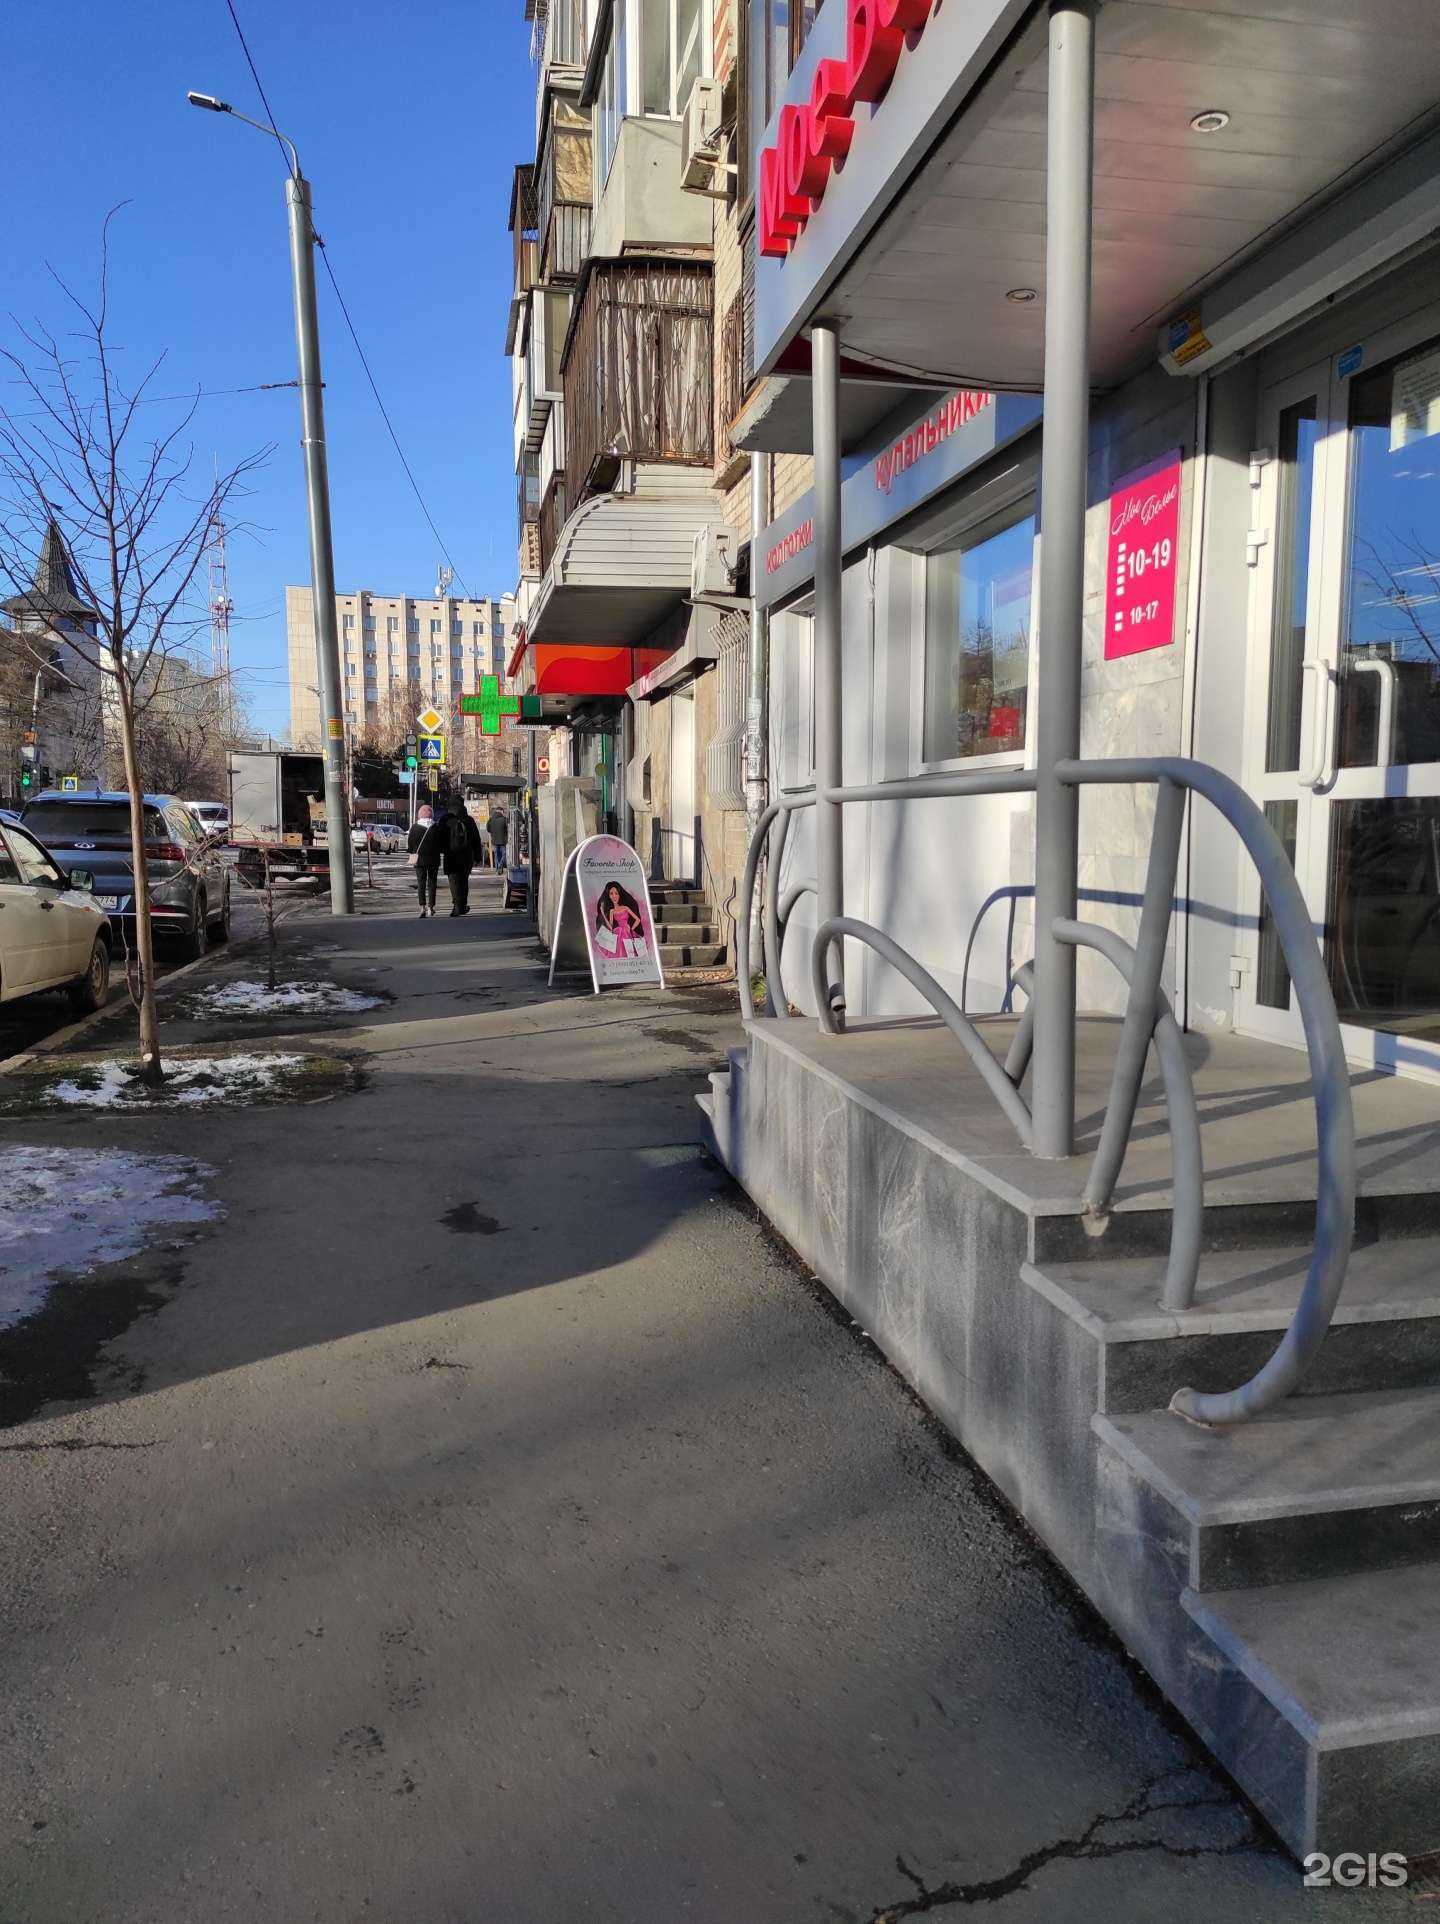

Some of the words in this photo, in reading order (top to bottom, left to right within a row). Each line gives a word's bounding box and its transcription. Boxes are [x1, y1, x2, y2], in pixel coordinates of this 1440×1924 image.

[1127, 537, 1172, 579] 10-19
[1130, 600, 1160, 625] 10-17
[583, 857, 616, 868] Favorite
[616, 857, 636, 871] Shop
